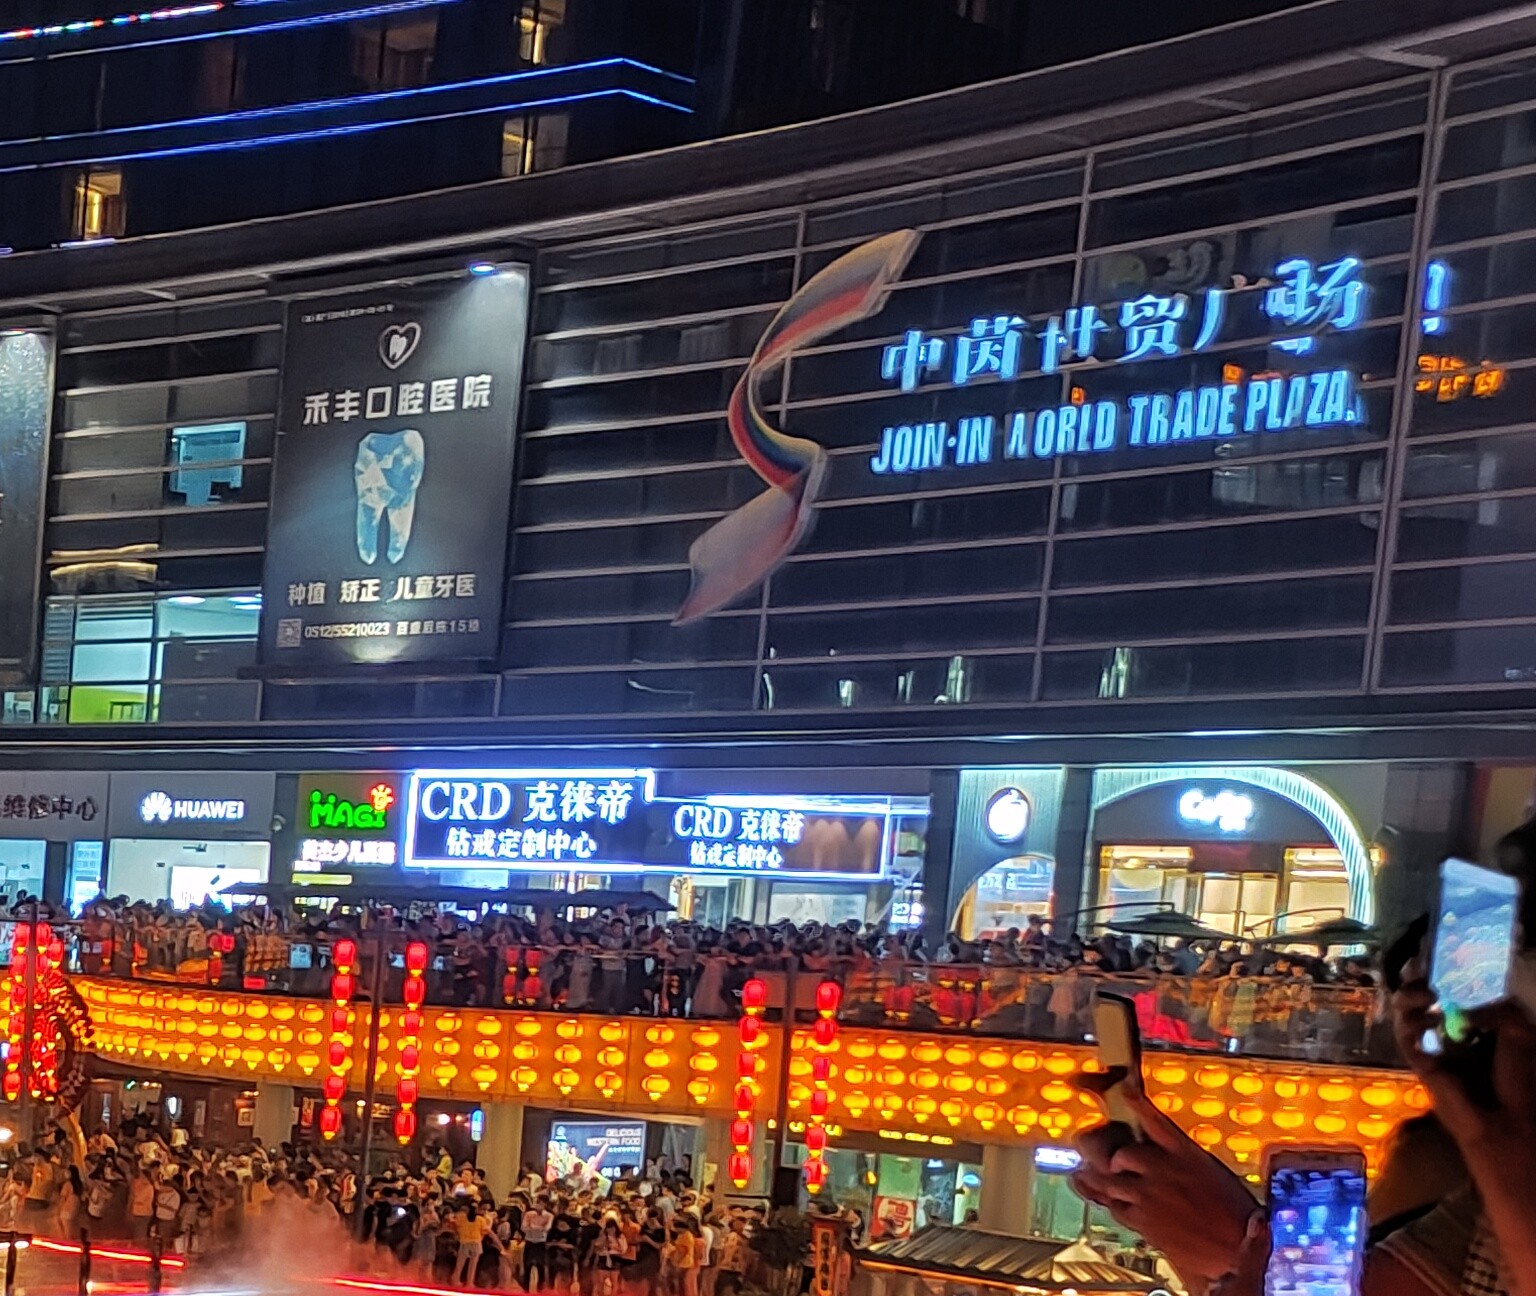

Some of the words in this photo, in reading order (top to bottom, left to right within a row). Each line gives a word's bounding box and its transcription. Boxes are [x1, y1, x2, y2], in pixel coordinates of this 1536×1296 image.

[303, 374, 492, 425] 禾丰口腔医院
[1129, 384, 1239, 447] TRADE
[288, 582, 327, 607] 种植
[339, 578, 381, 604] 矫正
[386, 574, 476, 603] 儿童牙医
[174, 800, 245, 819] HUAWEI
[309, 790, 386, 828] MAGI
[421, 781, 512, 821] CRD
[524, 779, 634, 825] 克徕帝
[673, 804, 733, 839] CRD
[445, 827, 598, 860] 钻戒定制中心
[690, 841, 785, 869] 钻戒定制中心
